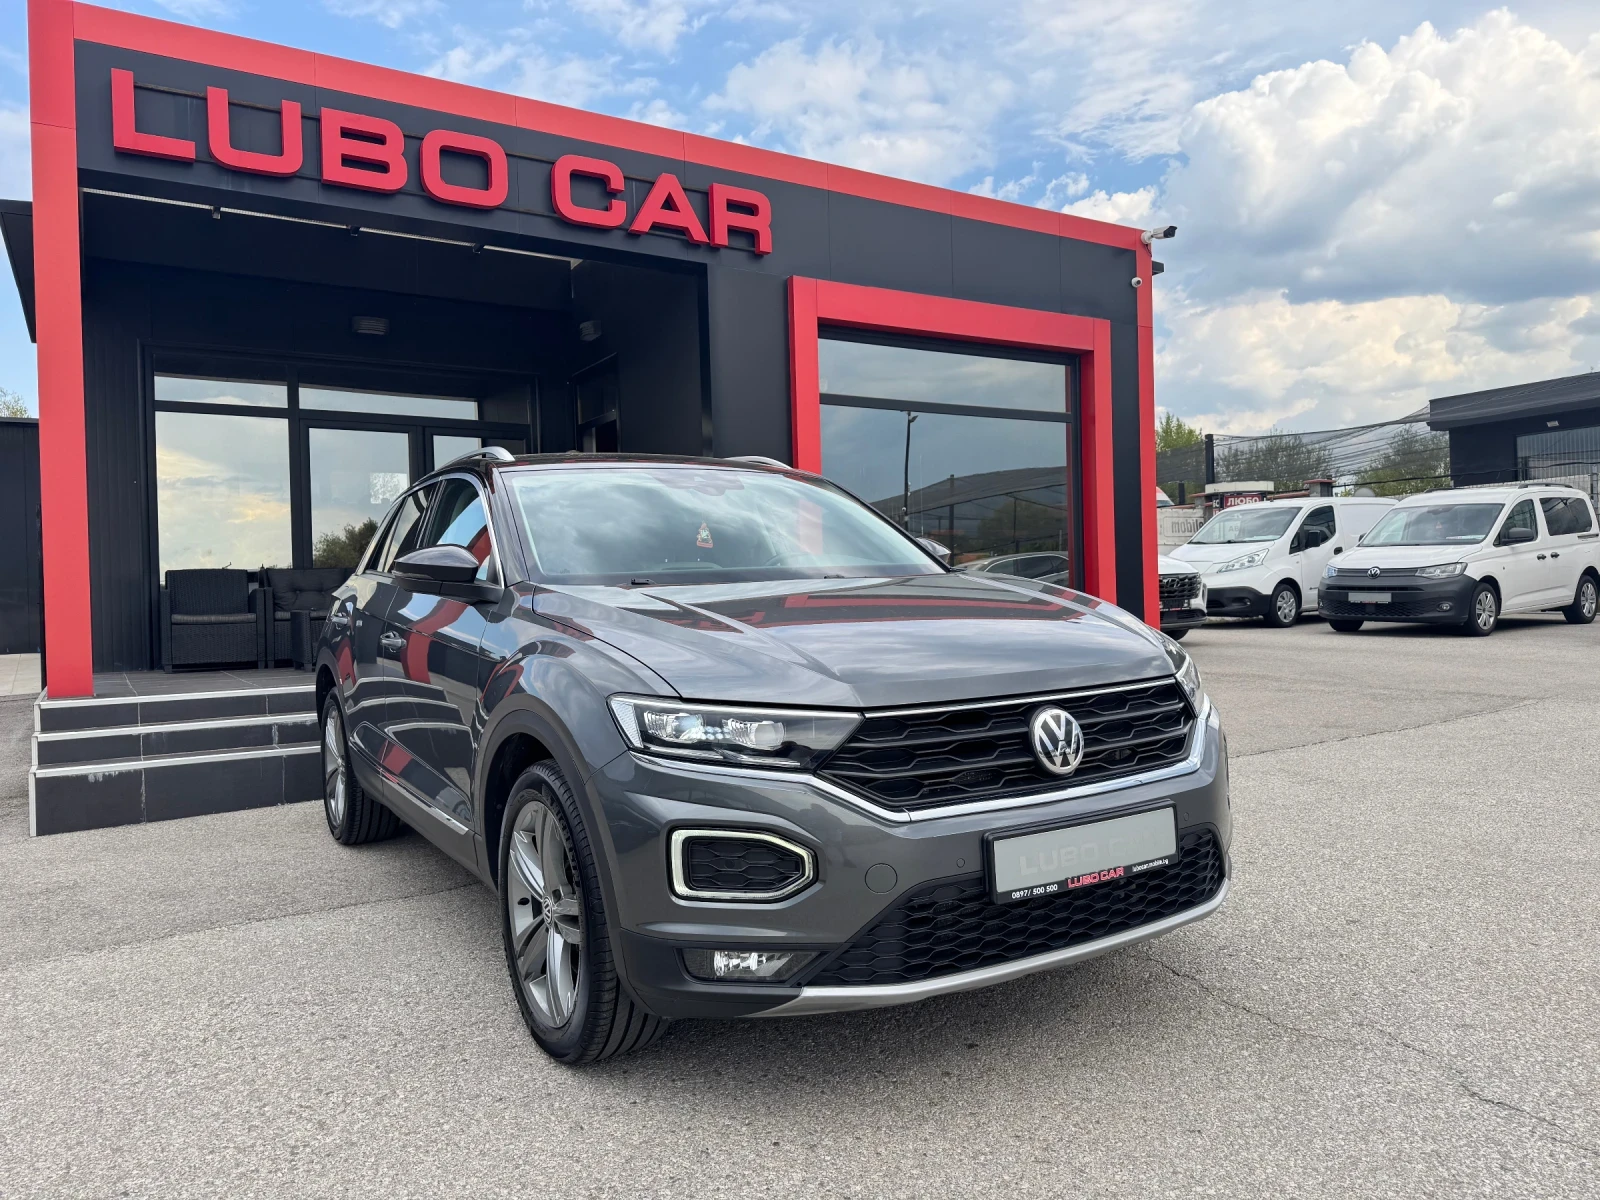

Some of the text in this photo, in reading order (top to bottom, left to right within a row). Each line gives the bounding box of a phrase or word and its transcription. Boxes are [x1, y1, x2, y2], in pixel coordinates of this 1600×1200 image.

[111, 68, 772, 255] LUBO CAR
[1067, 866, 1124, 888] LUBO CAR
[1032, 887, 1045, 896] 500
[1046, 884, 1058, 893] 500
